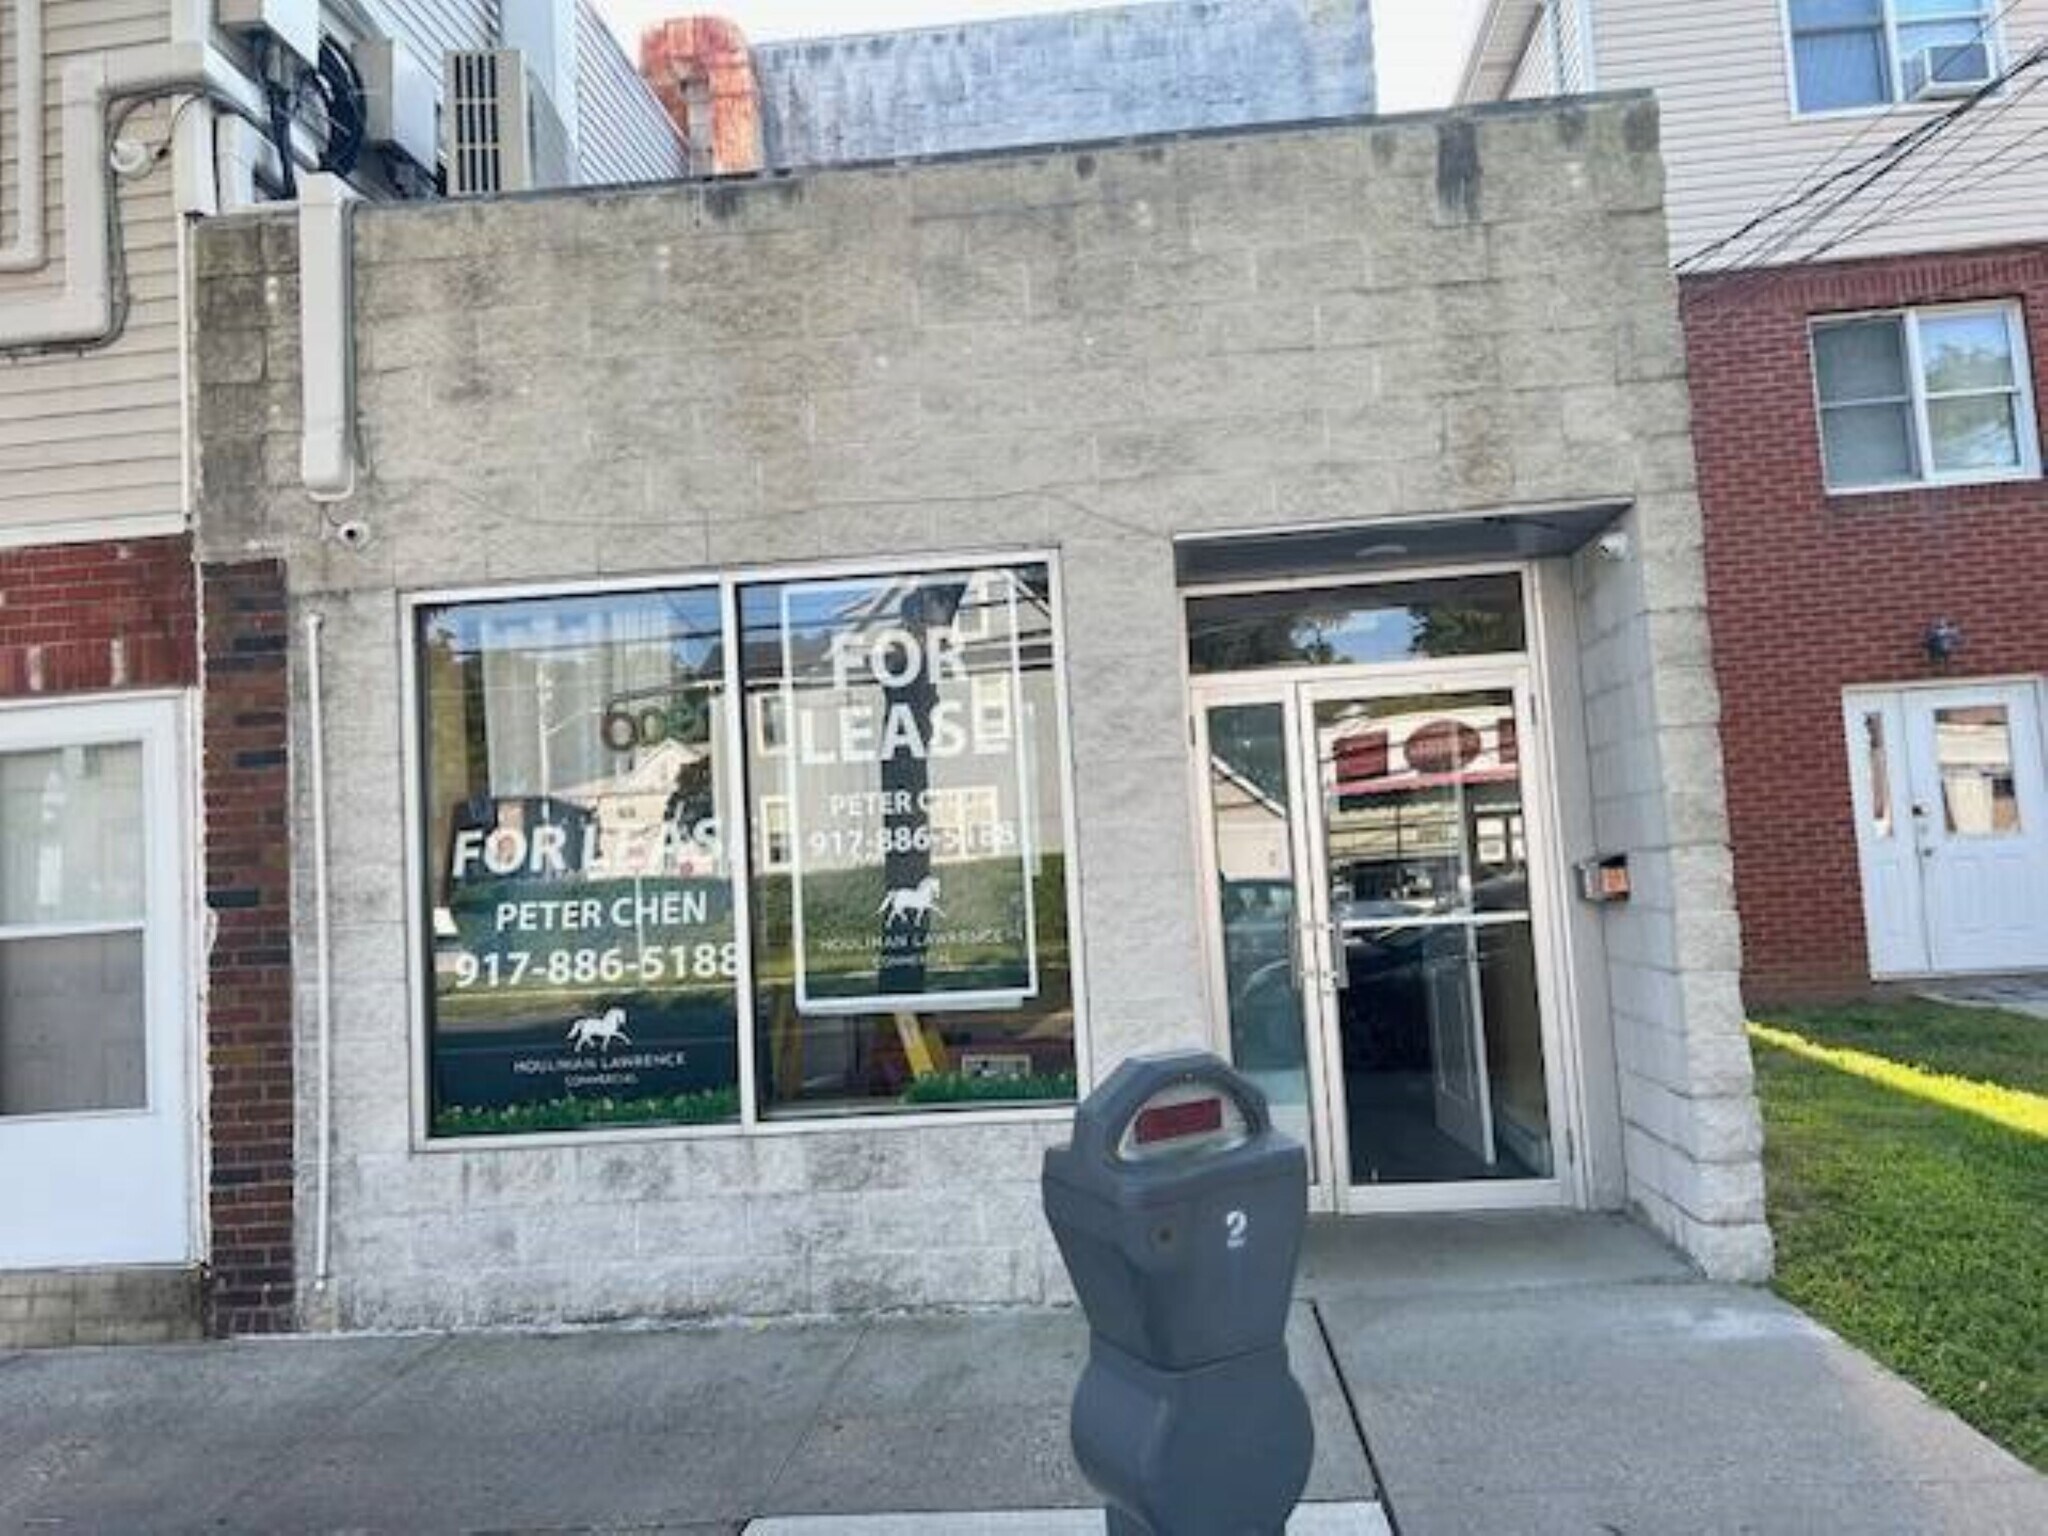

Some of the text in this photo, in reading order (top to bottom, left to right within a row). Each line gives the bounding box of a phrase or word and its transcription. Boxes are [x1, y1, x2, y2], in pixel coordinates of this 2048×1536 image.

[833, 626, 968, 690] FOR
[800, 699, 1008, 765] LEASE
[830, 789, 911, 818] PETER
[452, 823, 567, 878] FOR
[495, 890, 708, 933] PETER CHEN
[454, 941, 738, 989] 917-886-5188
[1225, 1210, 1248, 1249] 2
